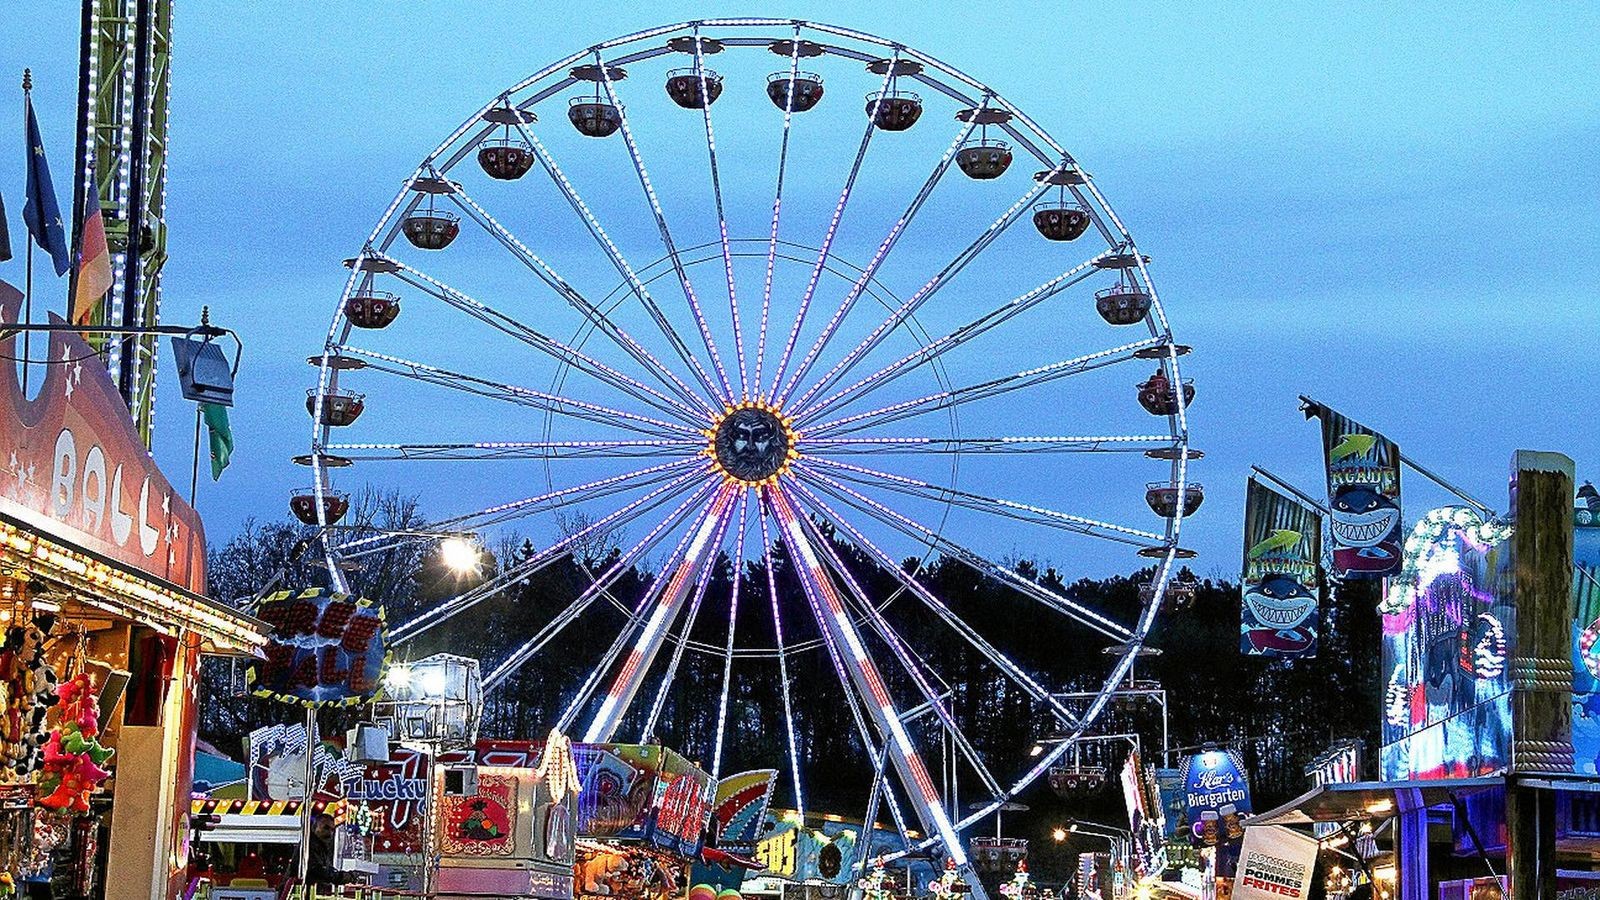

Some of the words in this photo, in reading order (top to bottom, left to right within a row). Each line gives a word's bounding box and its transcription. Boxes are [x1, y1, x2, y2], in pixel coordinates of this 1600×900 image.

[52, 428, 159, 557] BALL
[262, 644, 376, 693] FALL
[1193, 769, 1234, 790] Klar's
[345, 774, 429, 815] Lucky
[1187, 788, 1246, 808] Biergarten
[1242, 876, 1301, 898] FRITES
[1244, 868, 1302, 889] POMMES
